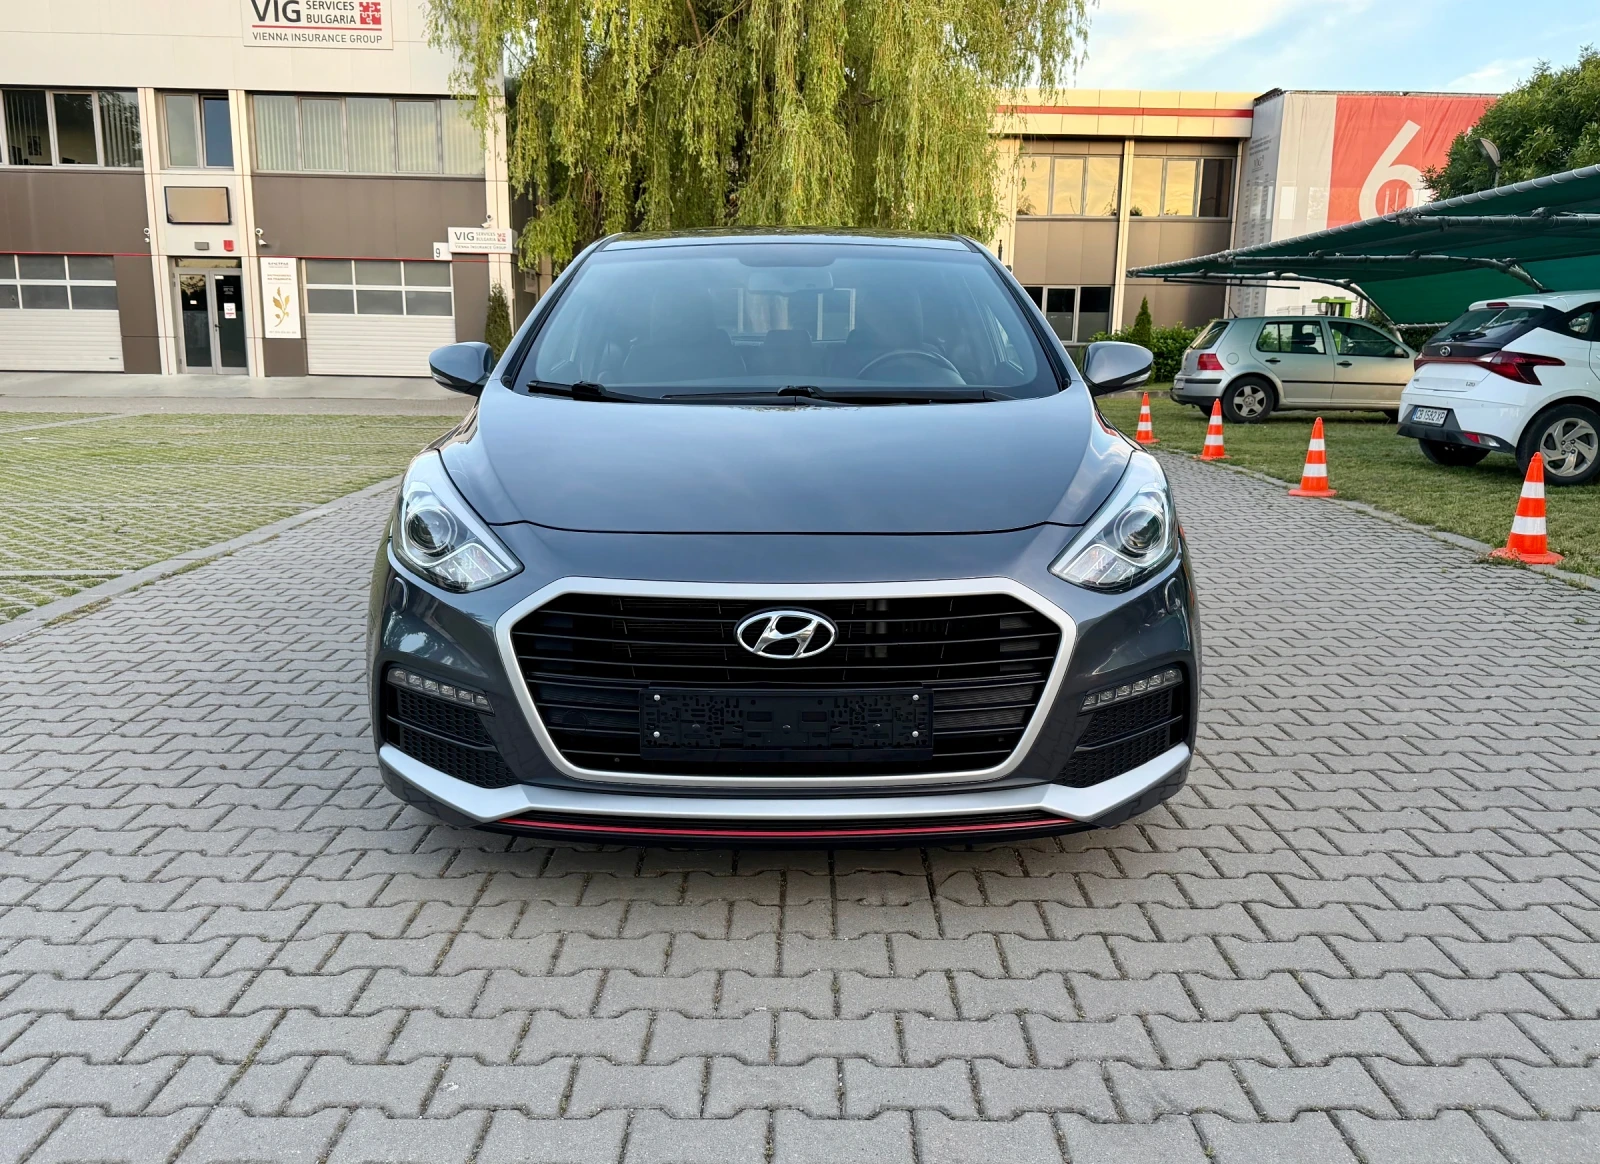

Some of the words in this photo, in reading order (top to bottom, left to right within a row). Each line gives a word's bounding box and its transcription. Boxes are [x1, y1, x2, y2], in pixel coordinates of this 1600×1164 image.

[306, 0, 355, 11] SERVICES
[251, 0, 301, 23] VIG
[306, 14, 356, 25] BULGARIA
[252, 32, 289, 42] VIENNA
[291, 33, 347, 43] INSURANCE
[349, 35, 382, 44] GROUP
[454, 232, 474, 241] VIG
[435, 248, 440, 257] 9
